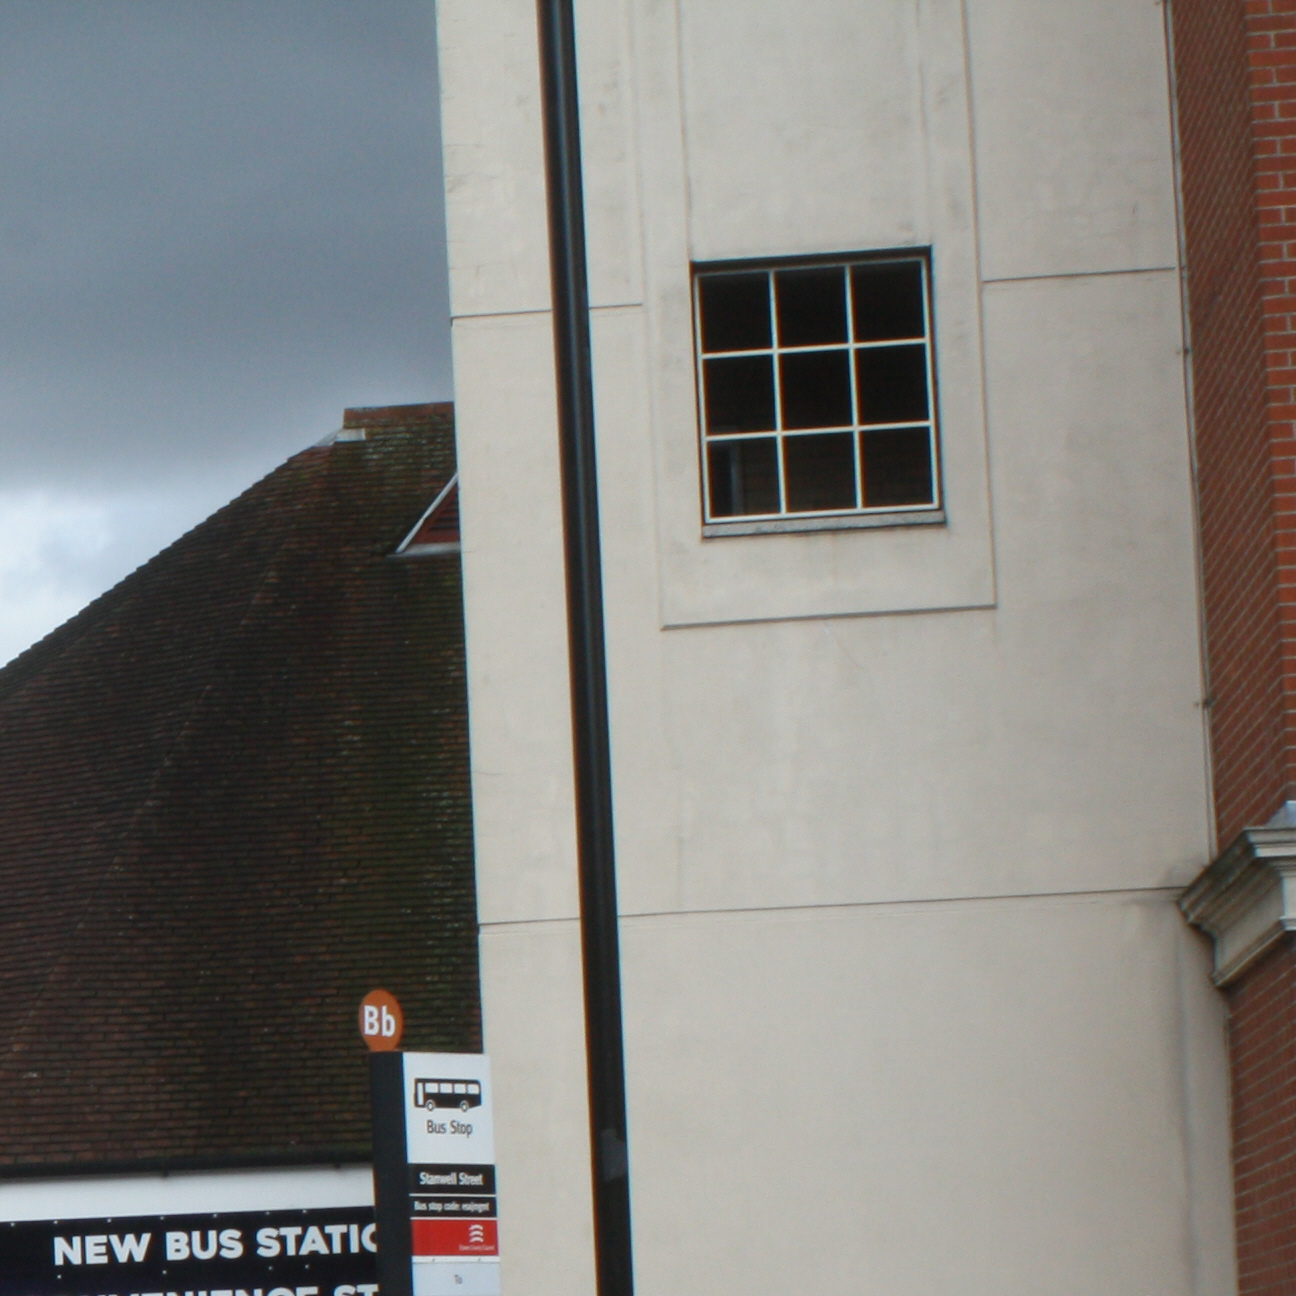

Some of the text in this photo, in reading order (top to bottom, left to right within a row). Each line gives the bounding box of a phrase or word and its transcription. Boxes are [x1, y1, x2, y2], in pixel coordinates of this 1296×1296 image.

[363, 1005, 395, 1037] Bb
[427, 1120, 473, 1138] Bus Stop
[54, 1233, 151, 1266] NEW
[166, 1229, 244, 1261] BUS
